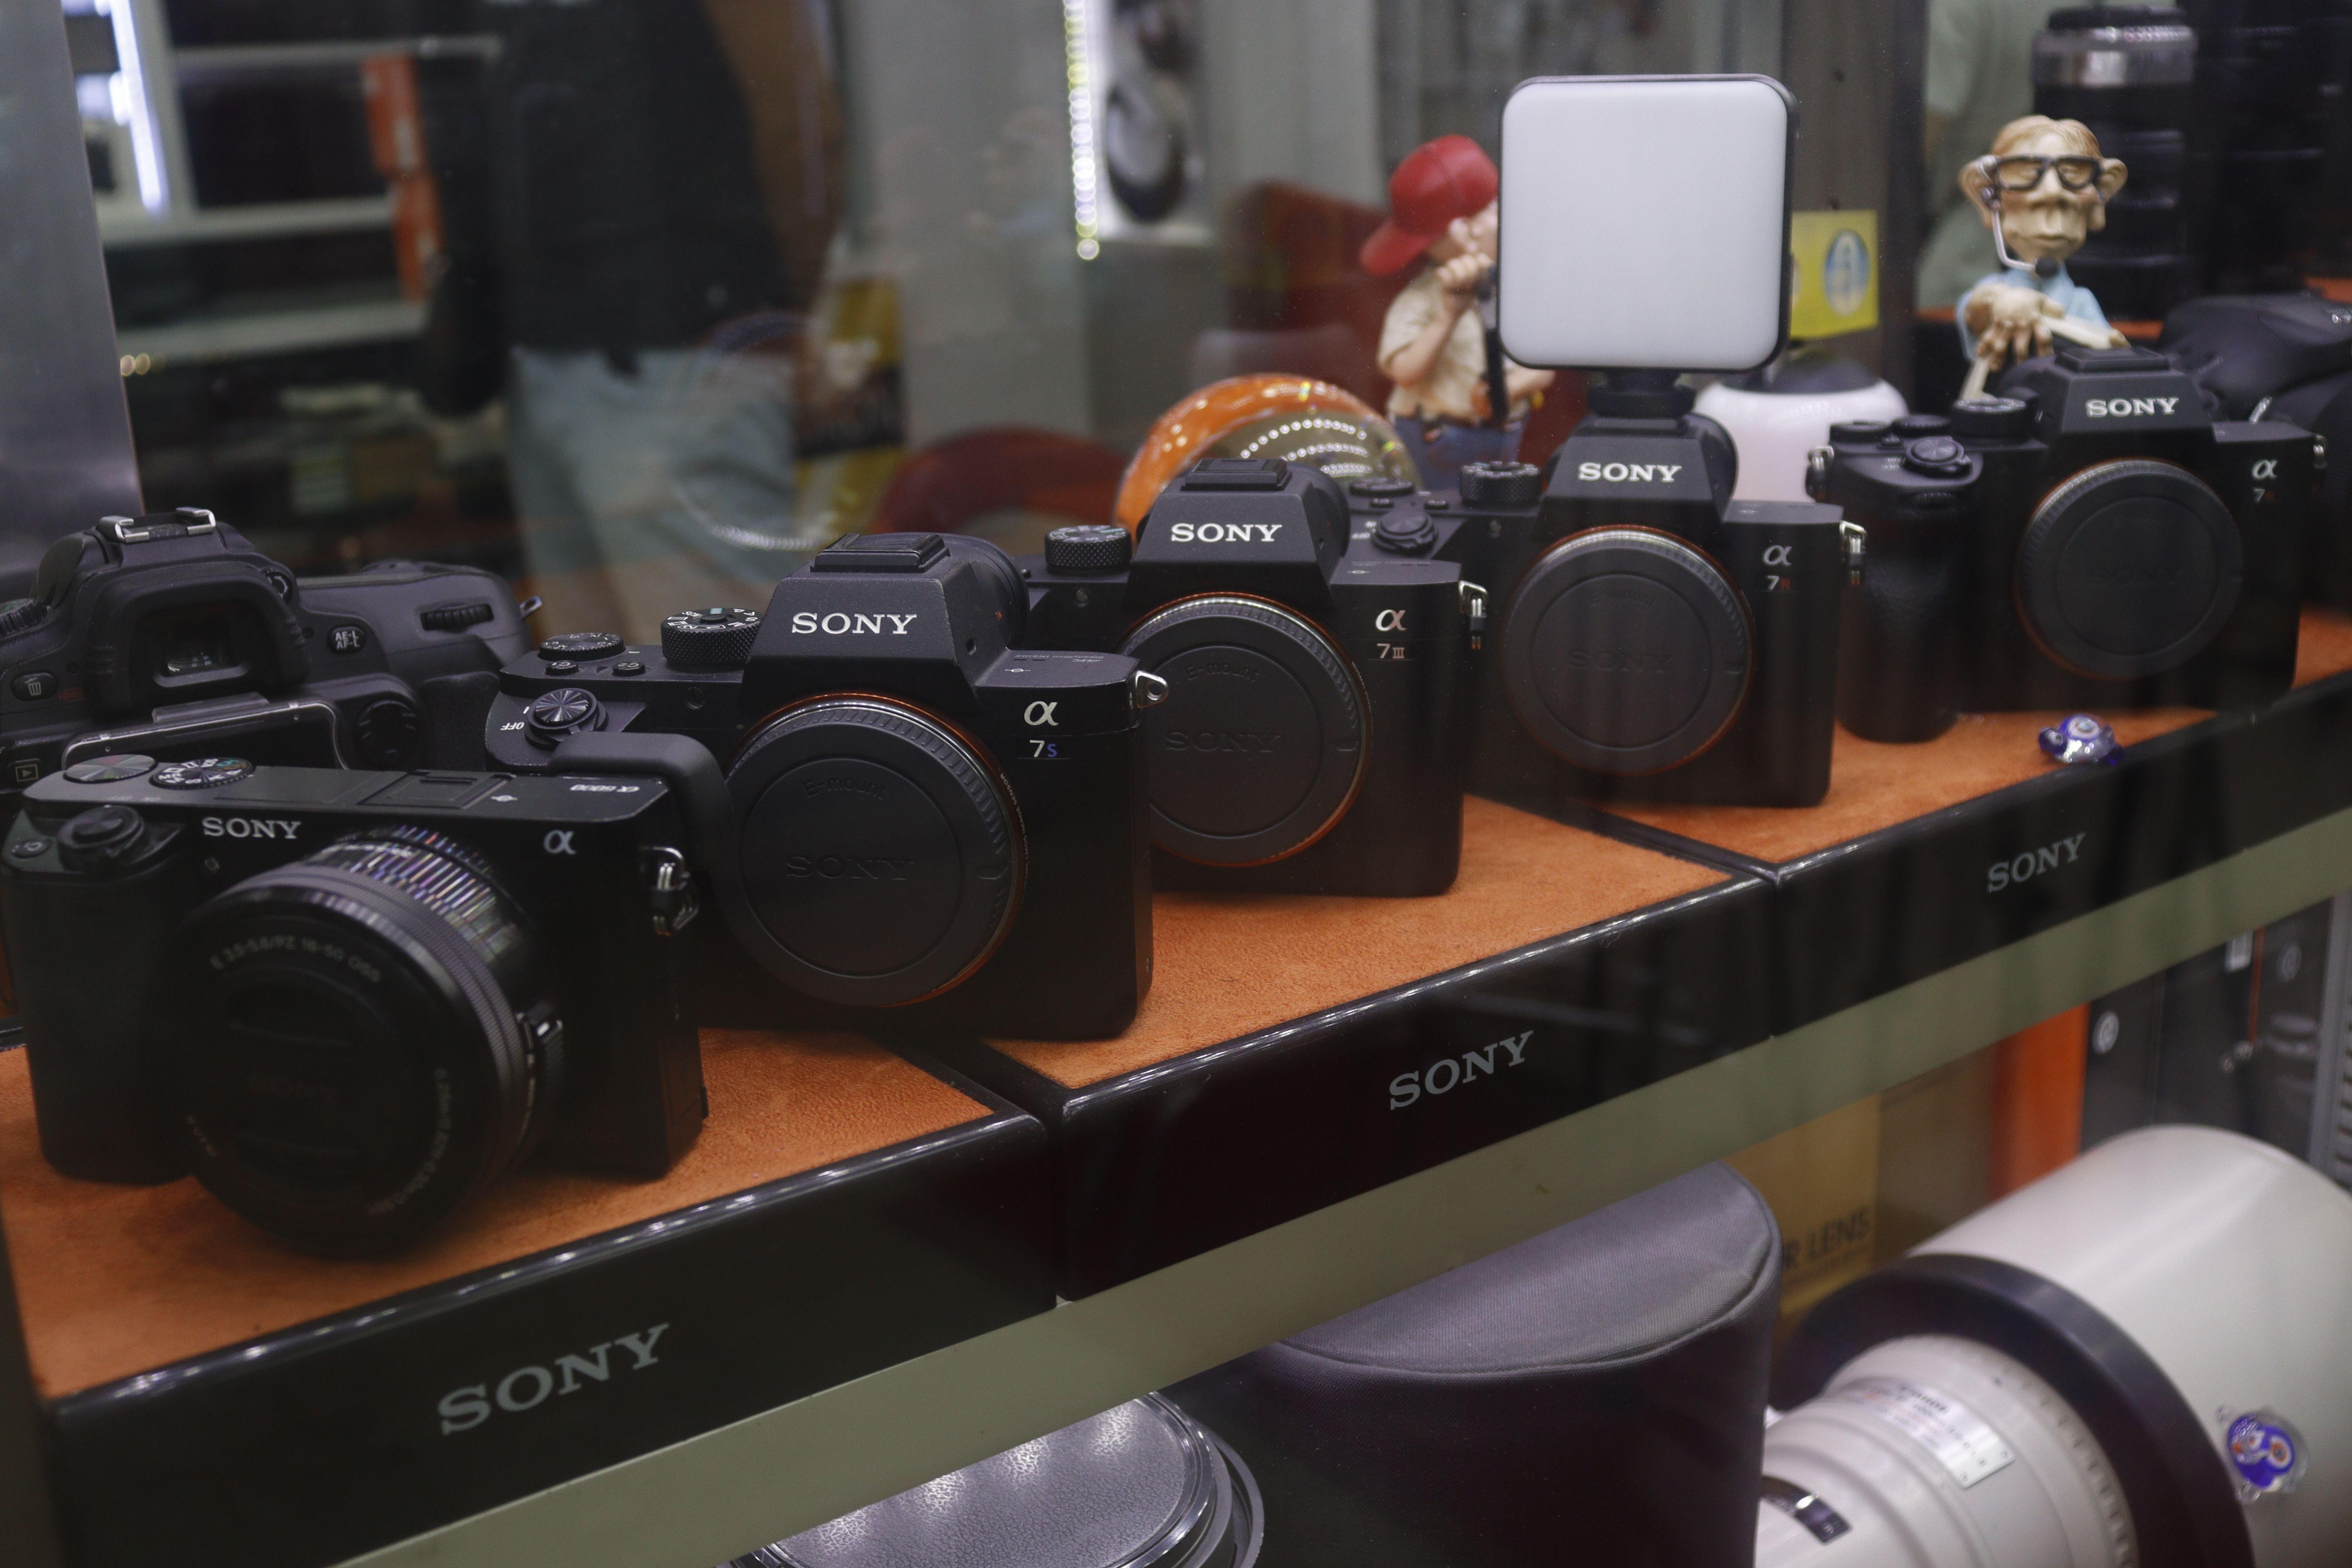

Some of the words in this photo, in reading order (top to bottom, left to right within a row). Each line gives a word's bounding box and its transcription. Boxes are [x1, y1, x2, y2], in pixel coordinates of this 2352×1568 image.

[2086, 397, 2179, 417] SONY
[1579, 462, 1682, 482] SONY
[1171, 523, 1282, 543] SONY
[791, 612, 917, 635] SONY
[335, 630, 359, 641] AE-L
[337, 639, 360, 649] AF-L
[1185, 663, 1260, 682] E-mount
[1568, 650, 1675, 673] SONY
[500, 722, 524, 731] OFF
[1165, 731, 1281, 753] SONY
[804, 776, 887, 800] E-mount
[1000, 773, 1018, 805] SENSOR
[202, 817, 301, 839] SONY
[1016, 806, 1025, 834] IMAGE
[786, 854, 914, 880] SONY
[1988, 833, 2086, 893] SONY
[1389, 1030, 1534, 1110] SONY
[437, 1323, 670, 1435] SONY
